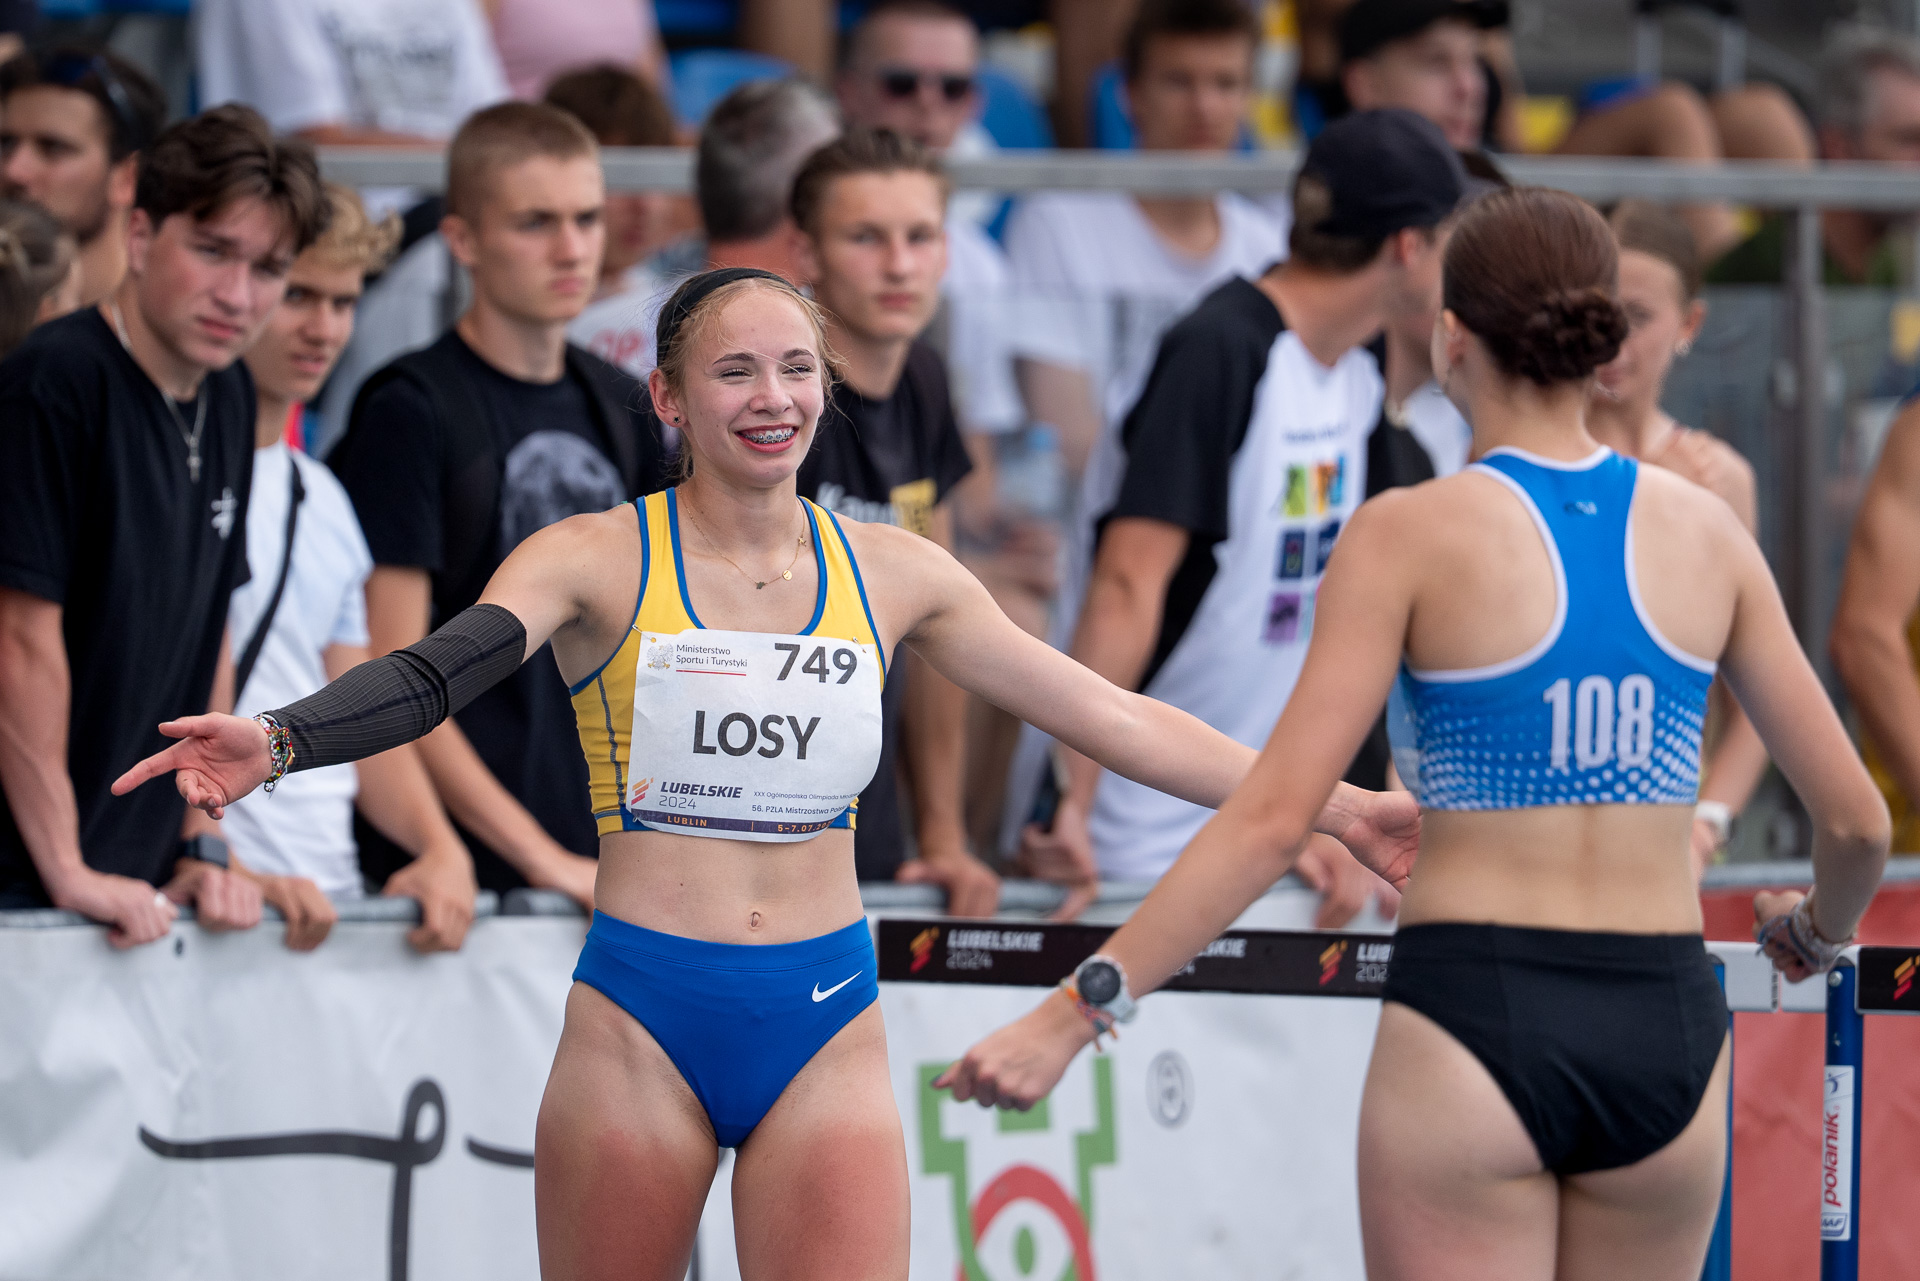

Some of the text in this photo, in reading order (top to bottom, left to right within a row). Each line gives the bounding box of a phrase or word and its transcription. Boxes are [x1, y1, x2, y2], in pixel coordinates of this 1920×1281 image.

[676, 644, 731, 656] Ministerstwo
[676, 655, 748, 668] Sportu i Turystyki
[775, 643, 857, 684] 749
[1542, 673, 1655, 773] 108
[692, 710, 821, 760] LOSY
[661, 782, 743, 798] LUBELSKIE
[766, 791, 808, 800] Ogólnopolska
[808, 793, 839, 801] Olimpiada
[659, 795, 697, 810] 2024
[752, 804, 764, 812] 56.
[765, 805, 784, 814] PZLA
[785, 806, 829, 815] Mistrzostwa
[667, 815, 708, 827] LUBLIN
[946, 929, 1044, 952] LUBELSKIE
[945, 948, 993, 970] 2024
[1355, 962, 1390, 983] 202
[1823, 1110, 1842, 1208] polanik
